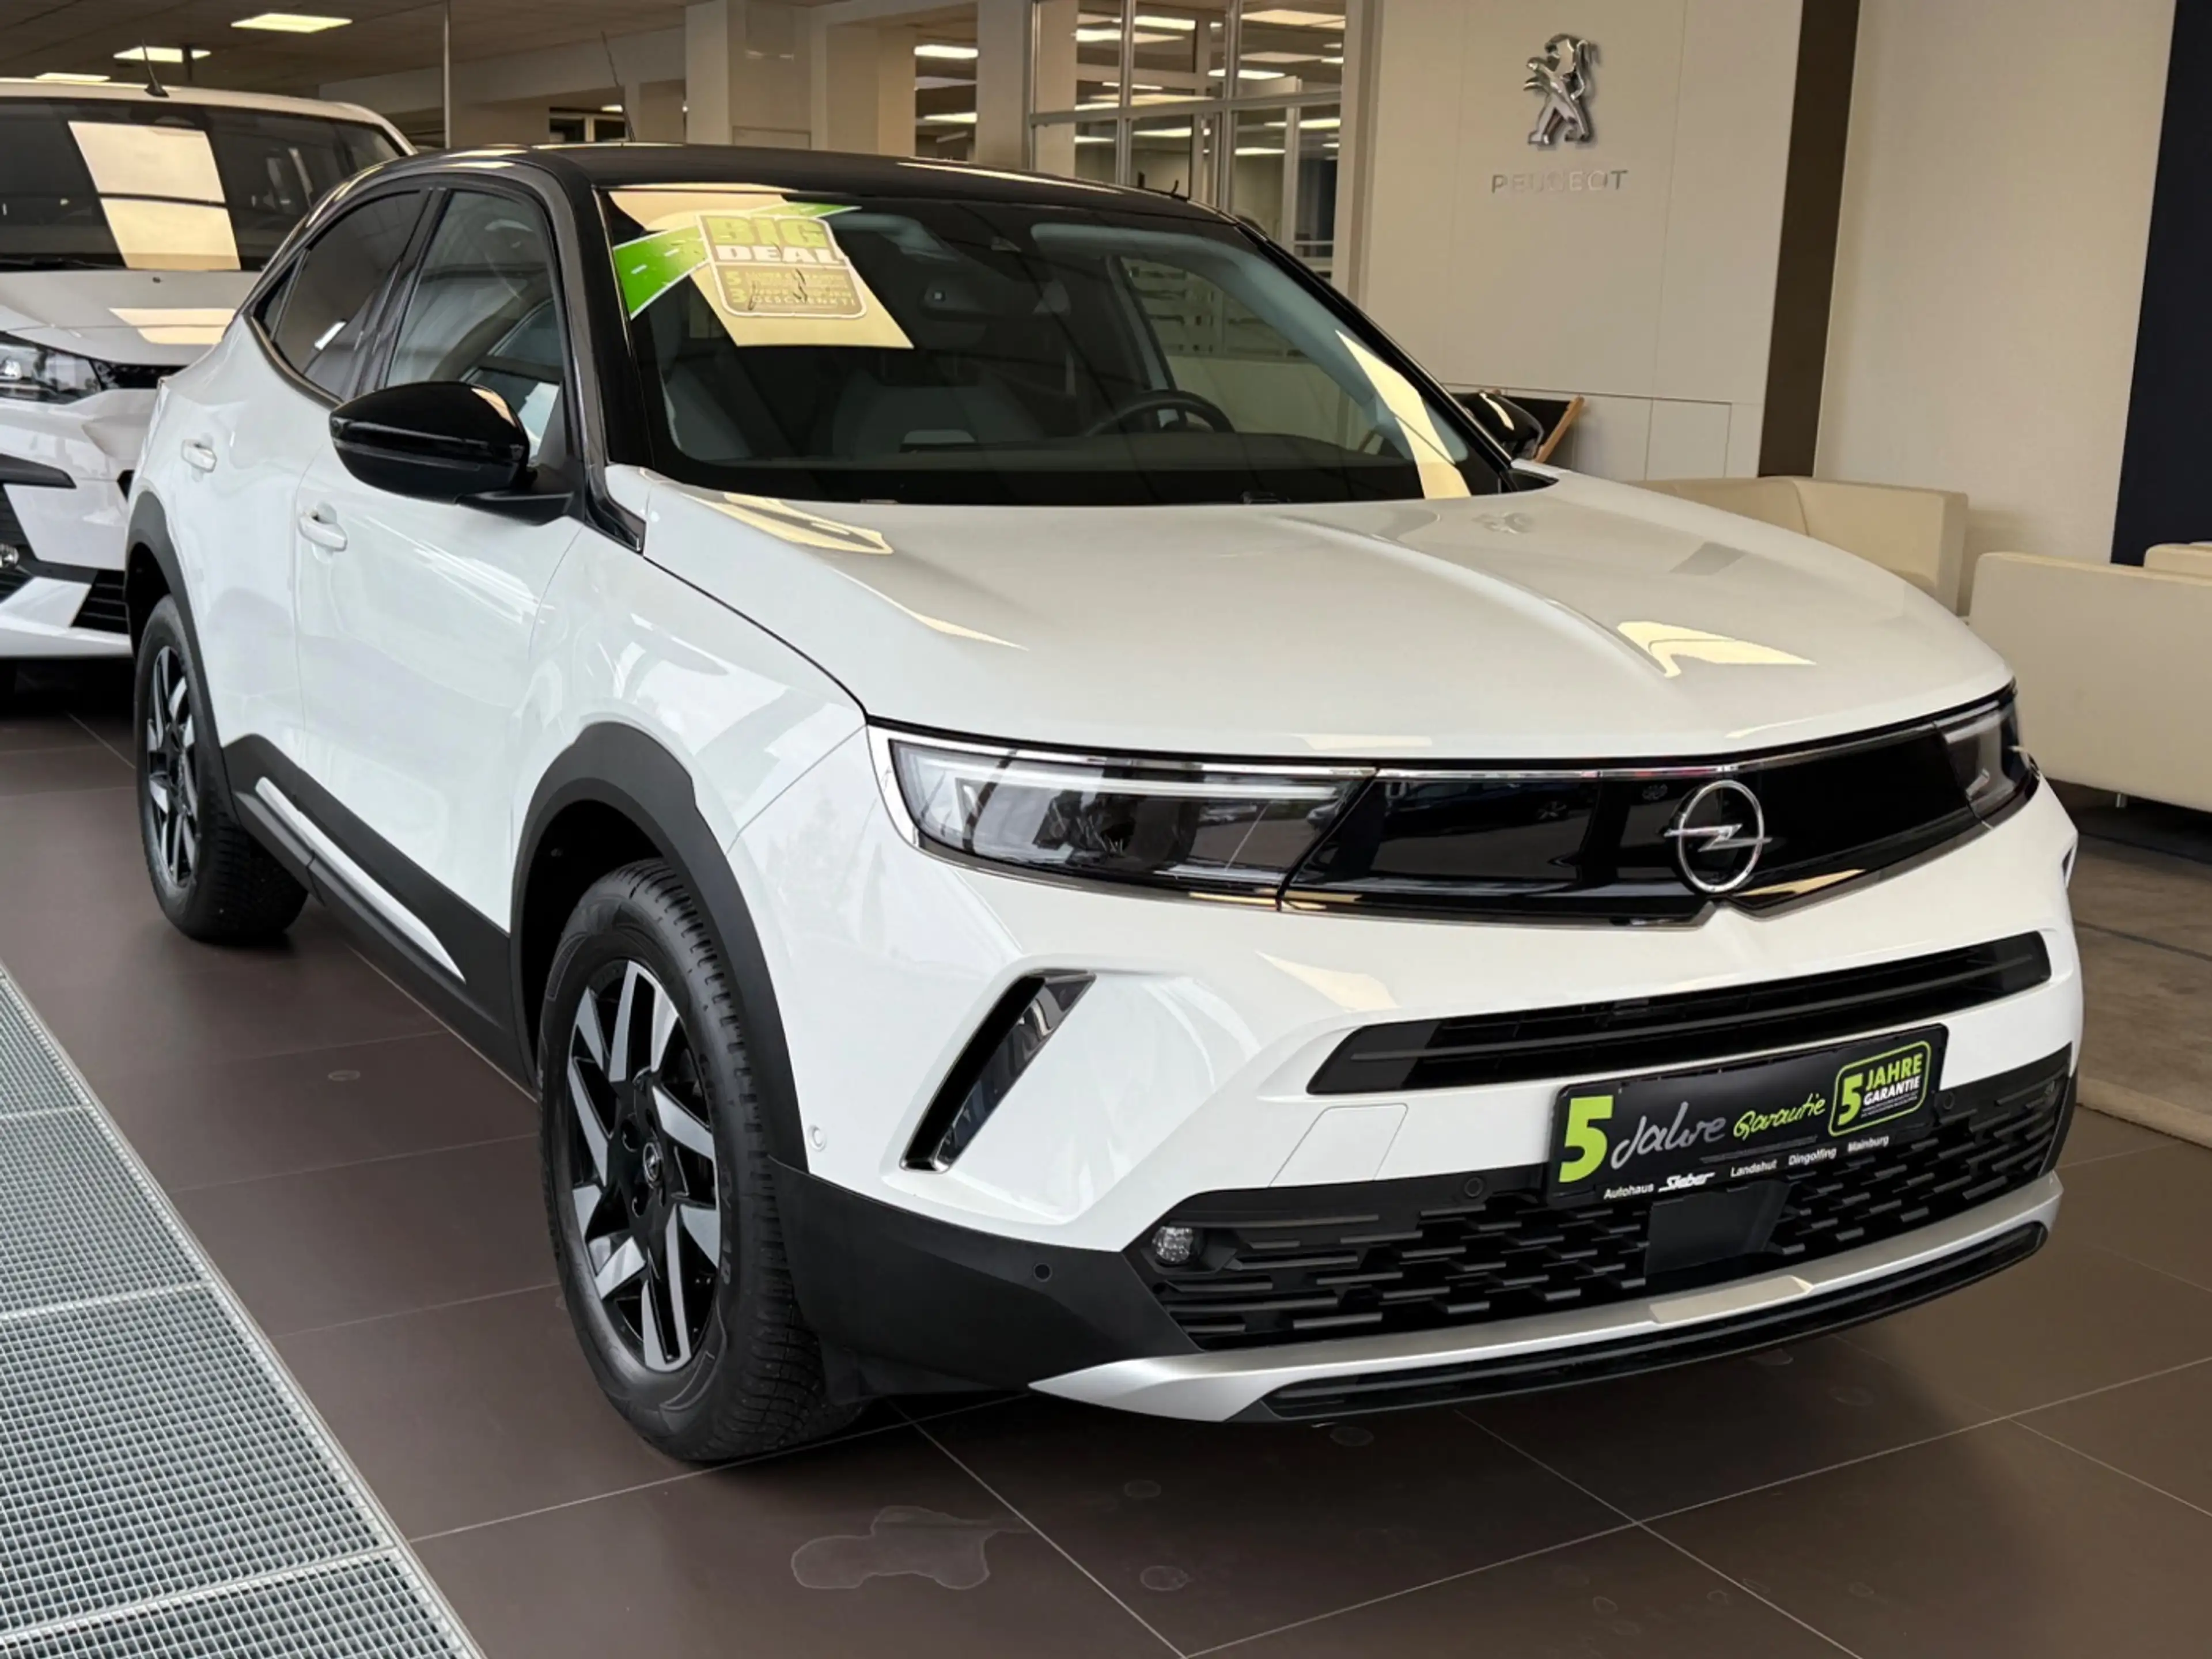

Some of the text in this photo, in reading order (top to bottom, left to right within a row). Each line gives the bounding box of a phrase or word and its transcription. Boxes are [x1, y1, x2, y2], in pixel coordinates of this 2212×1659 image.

[1491, 169, 1628, 194] PEUGEOT
[706, 217, 828, 248] BIG
[716, 244, 842, 264] DEAL
[730, 289, 748, 303] 3
[1865, 1052, 1923, 1092] JAHRE
[1838, 1072, 1864, 1126] 5
[1863, 1075, 1922, 1106] GARANTIE
[1558, 1094, 1613, 1183] 5
[1611, 1101, 1727, 1170] Jahre
[1733, 1093, 1826, 1141] Garantie
[1603, 1183, 1654, 1199] Autohaus
[1730, 1159, 1778, 1178] Landshut
[1788, 1147, 1838, 1166] Dingolfing
